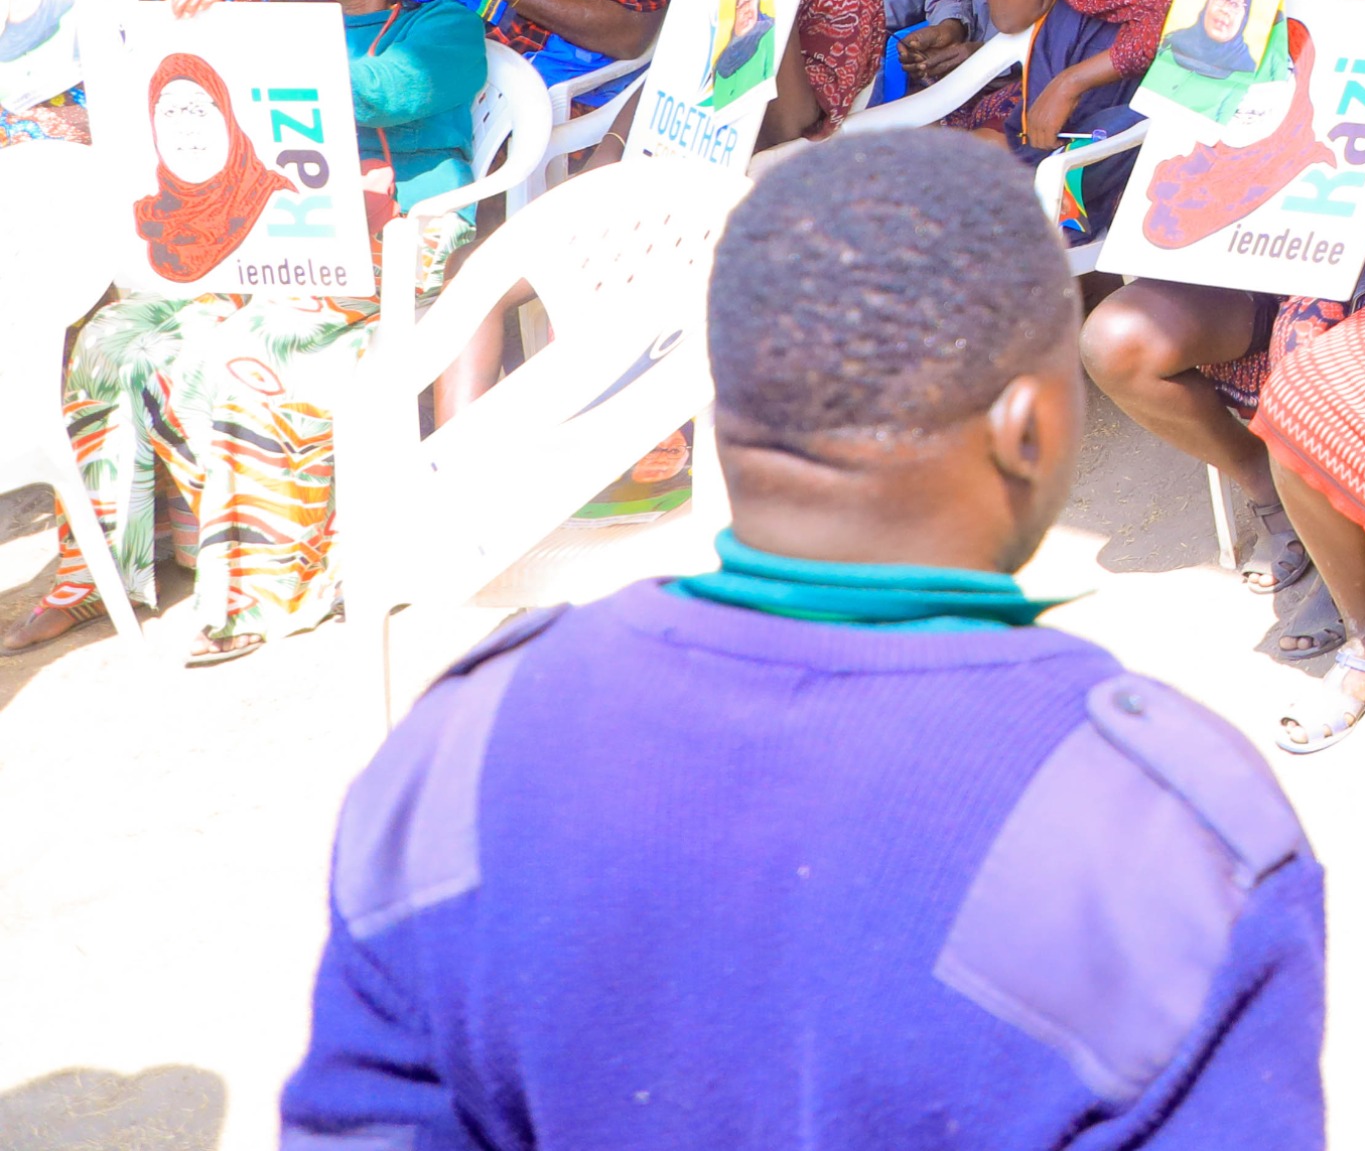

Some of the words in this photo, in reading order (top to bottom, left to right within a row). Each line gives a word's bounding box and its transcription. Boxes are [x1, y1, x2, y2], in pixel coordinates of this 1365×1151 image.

[650, 90, 738, 167] TOGETHER
[1227, 224, 1345, 265] iendelee
[237, 259, 347, 286] iendelee
